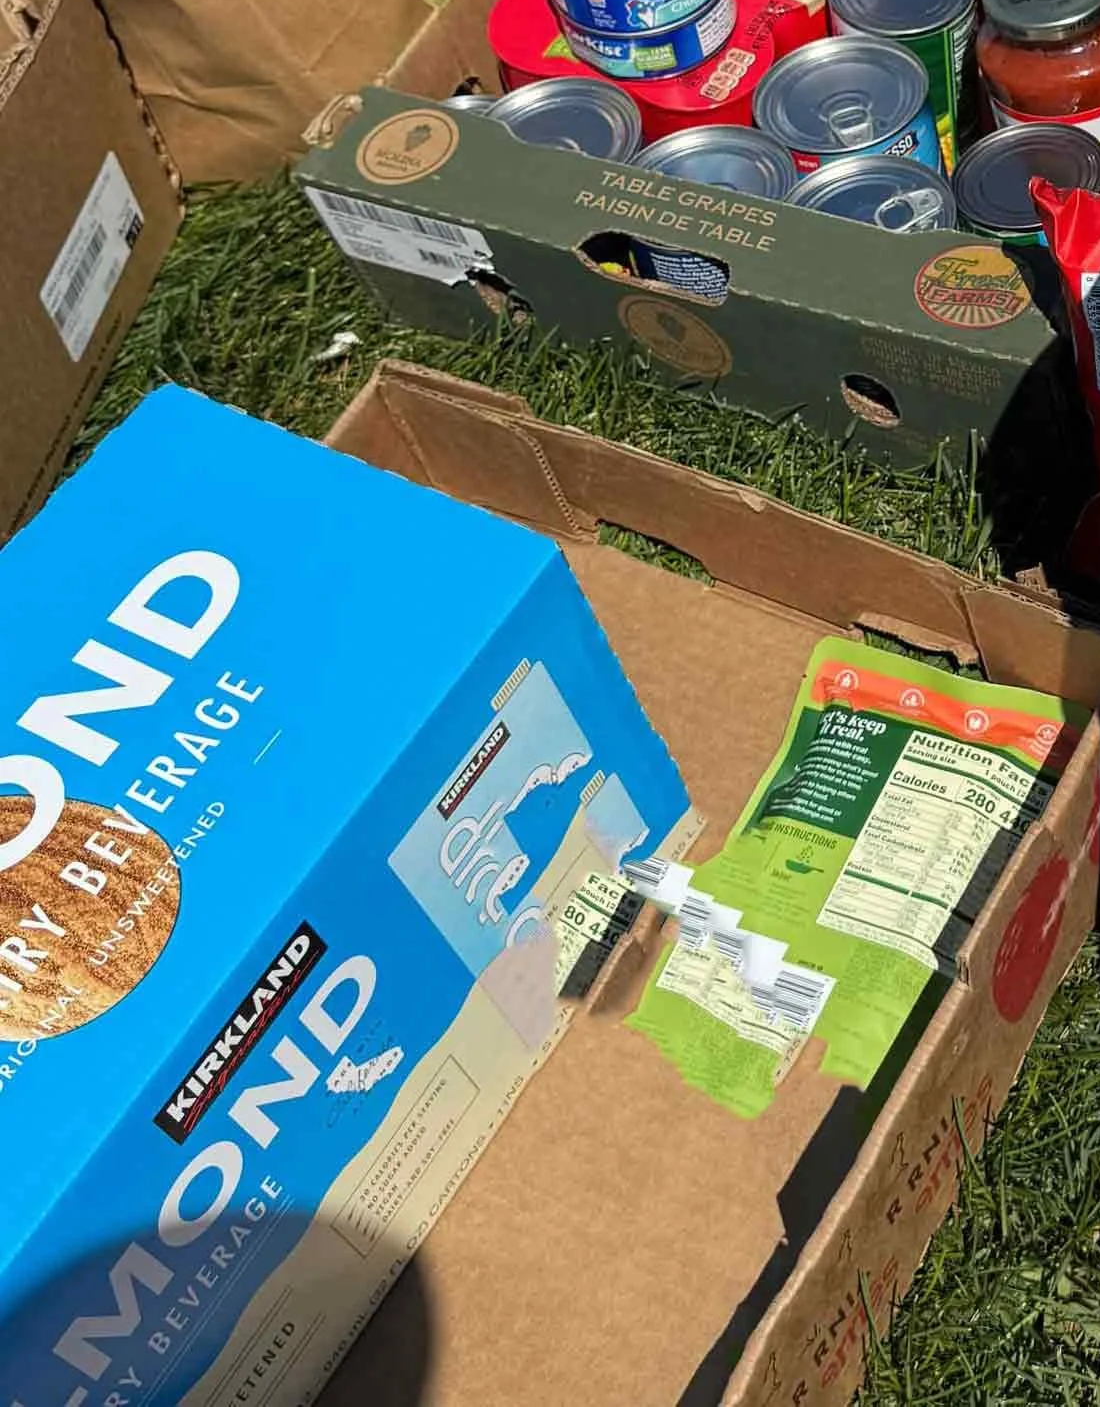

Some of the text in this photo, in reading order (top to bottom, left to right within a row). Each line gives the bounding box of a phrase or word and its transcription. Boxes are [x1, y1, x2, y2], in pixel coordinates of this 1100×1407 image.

[574, 190, 777, 253] RAISIN DE TABLE
[599, 171, 778, 228] TABLE GRAPES
[828, 723, 866, 742] real.
[848, 713, 888, 736] keep
[912, 734, 993, 767] Nutrition
[58, 671, 264, 895] BEVERAGE
[442, 727, 504, 811] KIRKLAND
[892, 770, 948, 796] Calories
[963, 788, 997, 815] 280
[773, 823, 838, 851] INSTRUCTIONS
[89, 801, 227, 967] UNSWEETENED
[164, 932, 313, 1126] KIRKLAND
[428, 1135, 486, 1213] CARTONS
[148, 1176, 285, 1358] BEVERAGE
